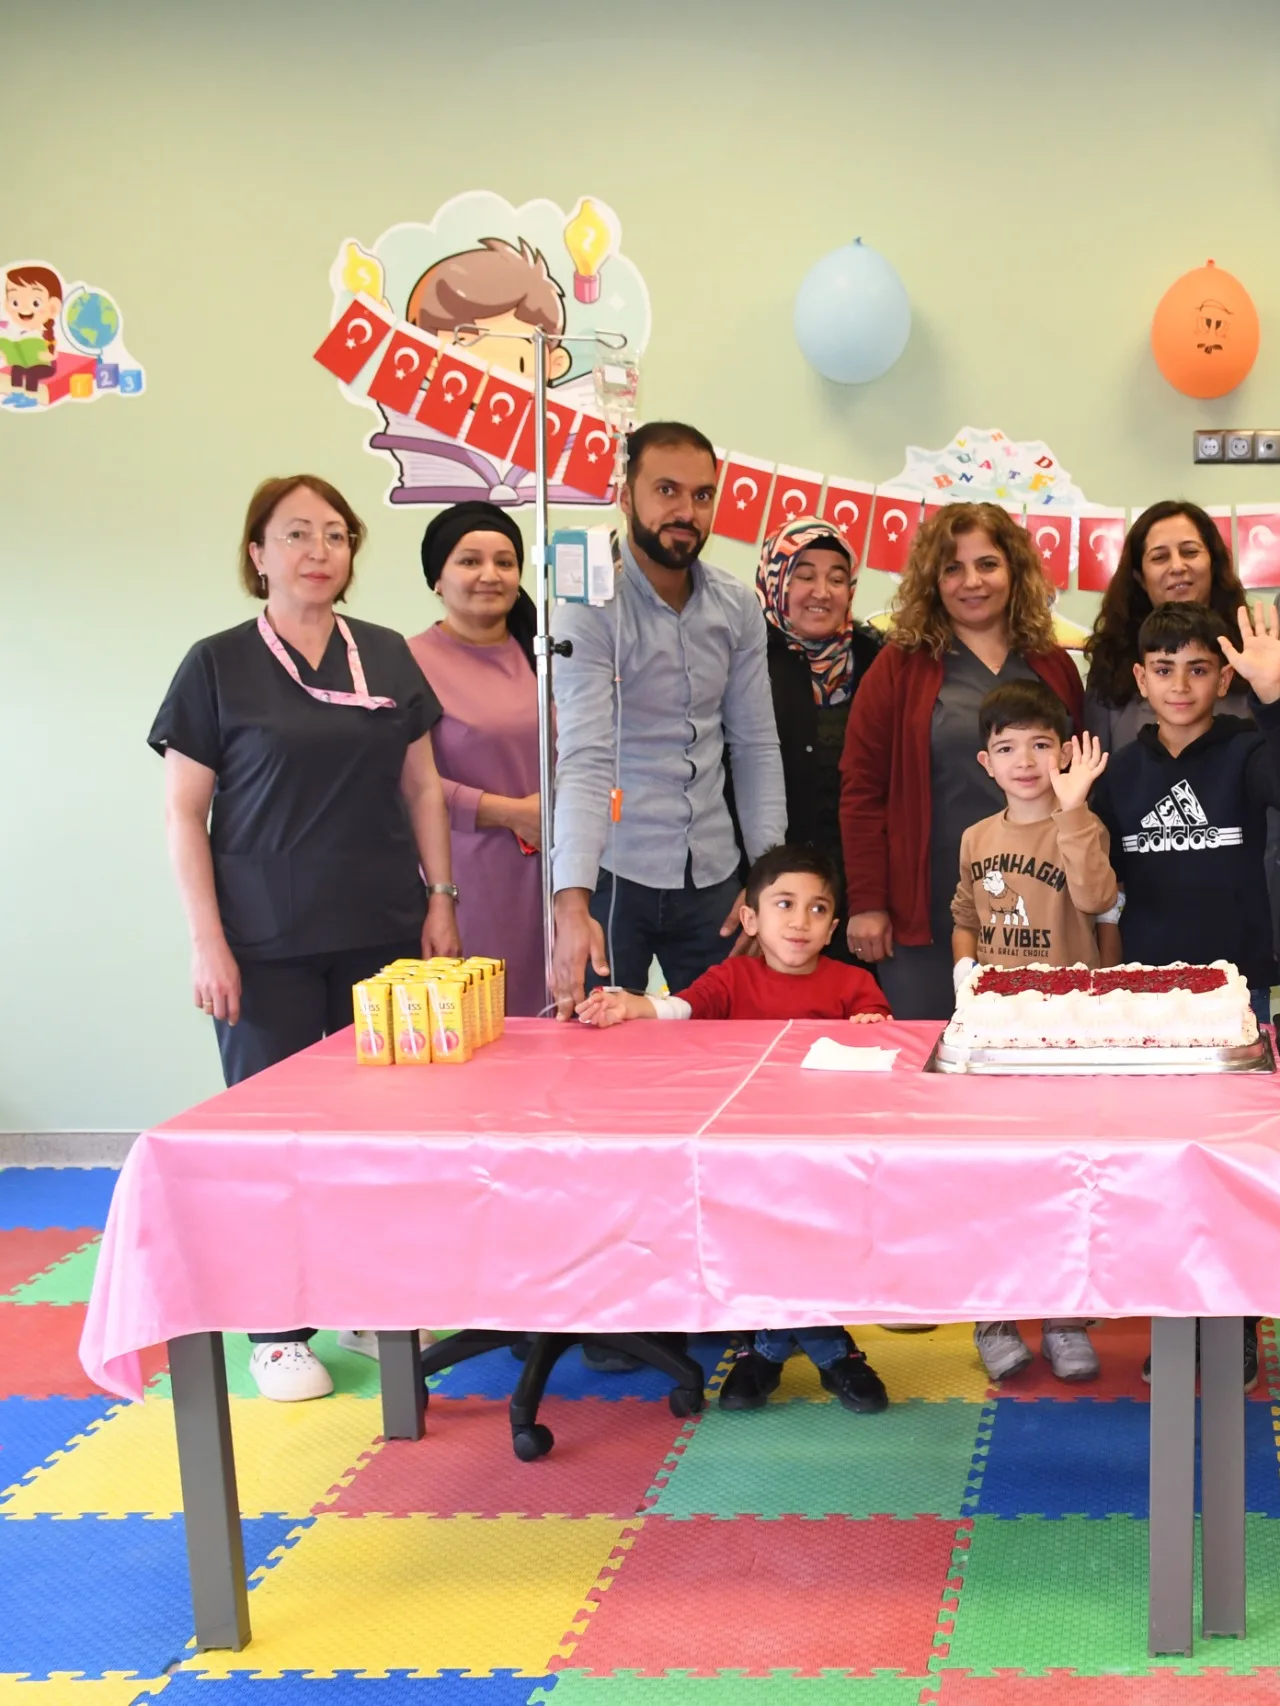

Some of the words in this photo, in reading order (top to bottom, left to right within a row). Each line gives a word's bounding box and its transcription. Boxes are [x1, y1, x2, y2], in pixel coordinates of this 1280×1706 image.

[100, 370, 113, 388] 2
[124, 375, 135, 393] 3
[1033, 455, 1054, 469] D
[1027, 472, 1055, 491] F
[1137, 825, 1220, 853] adidas
[971, 853, 1067, 892] OPENHAGEN
[1003, 927, 1051, 949] VIBES
[998, 948, 1019, 957] GREAT
[1023, 949, 1049, 958] CHOICE
